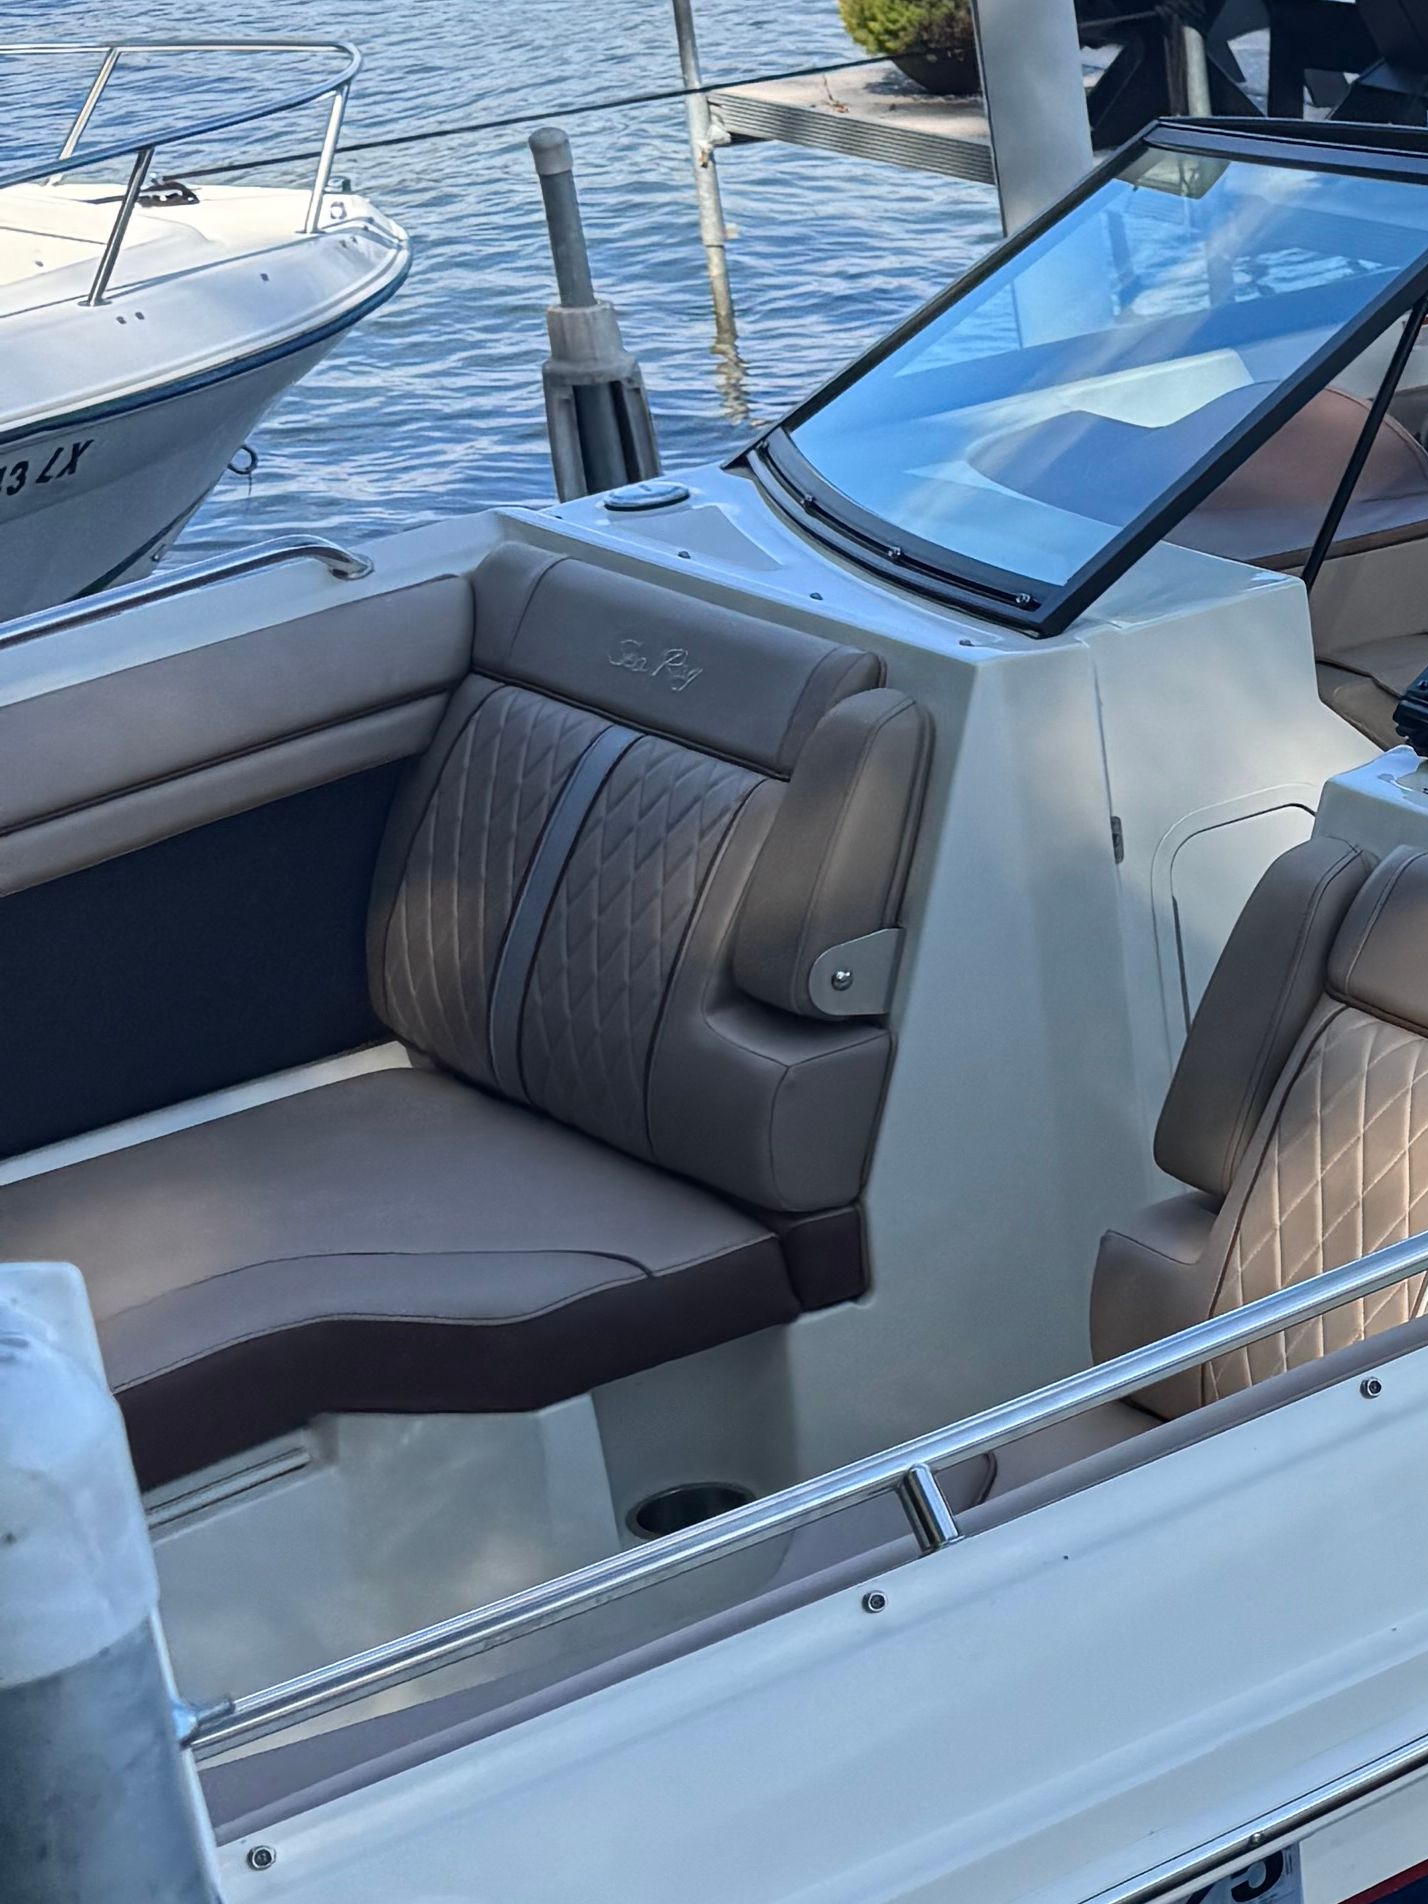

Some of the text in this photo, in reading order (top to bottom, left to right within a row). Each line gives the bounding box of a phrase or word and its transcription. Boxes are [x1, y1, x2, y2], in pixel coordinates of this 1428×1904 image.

[35, 439, 95, 484] LX
[606, 639, 703, 691] Sea Ray
